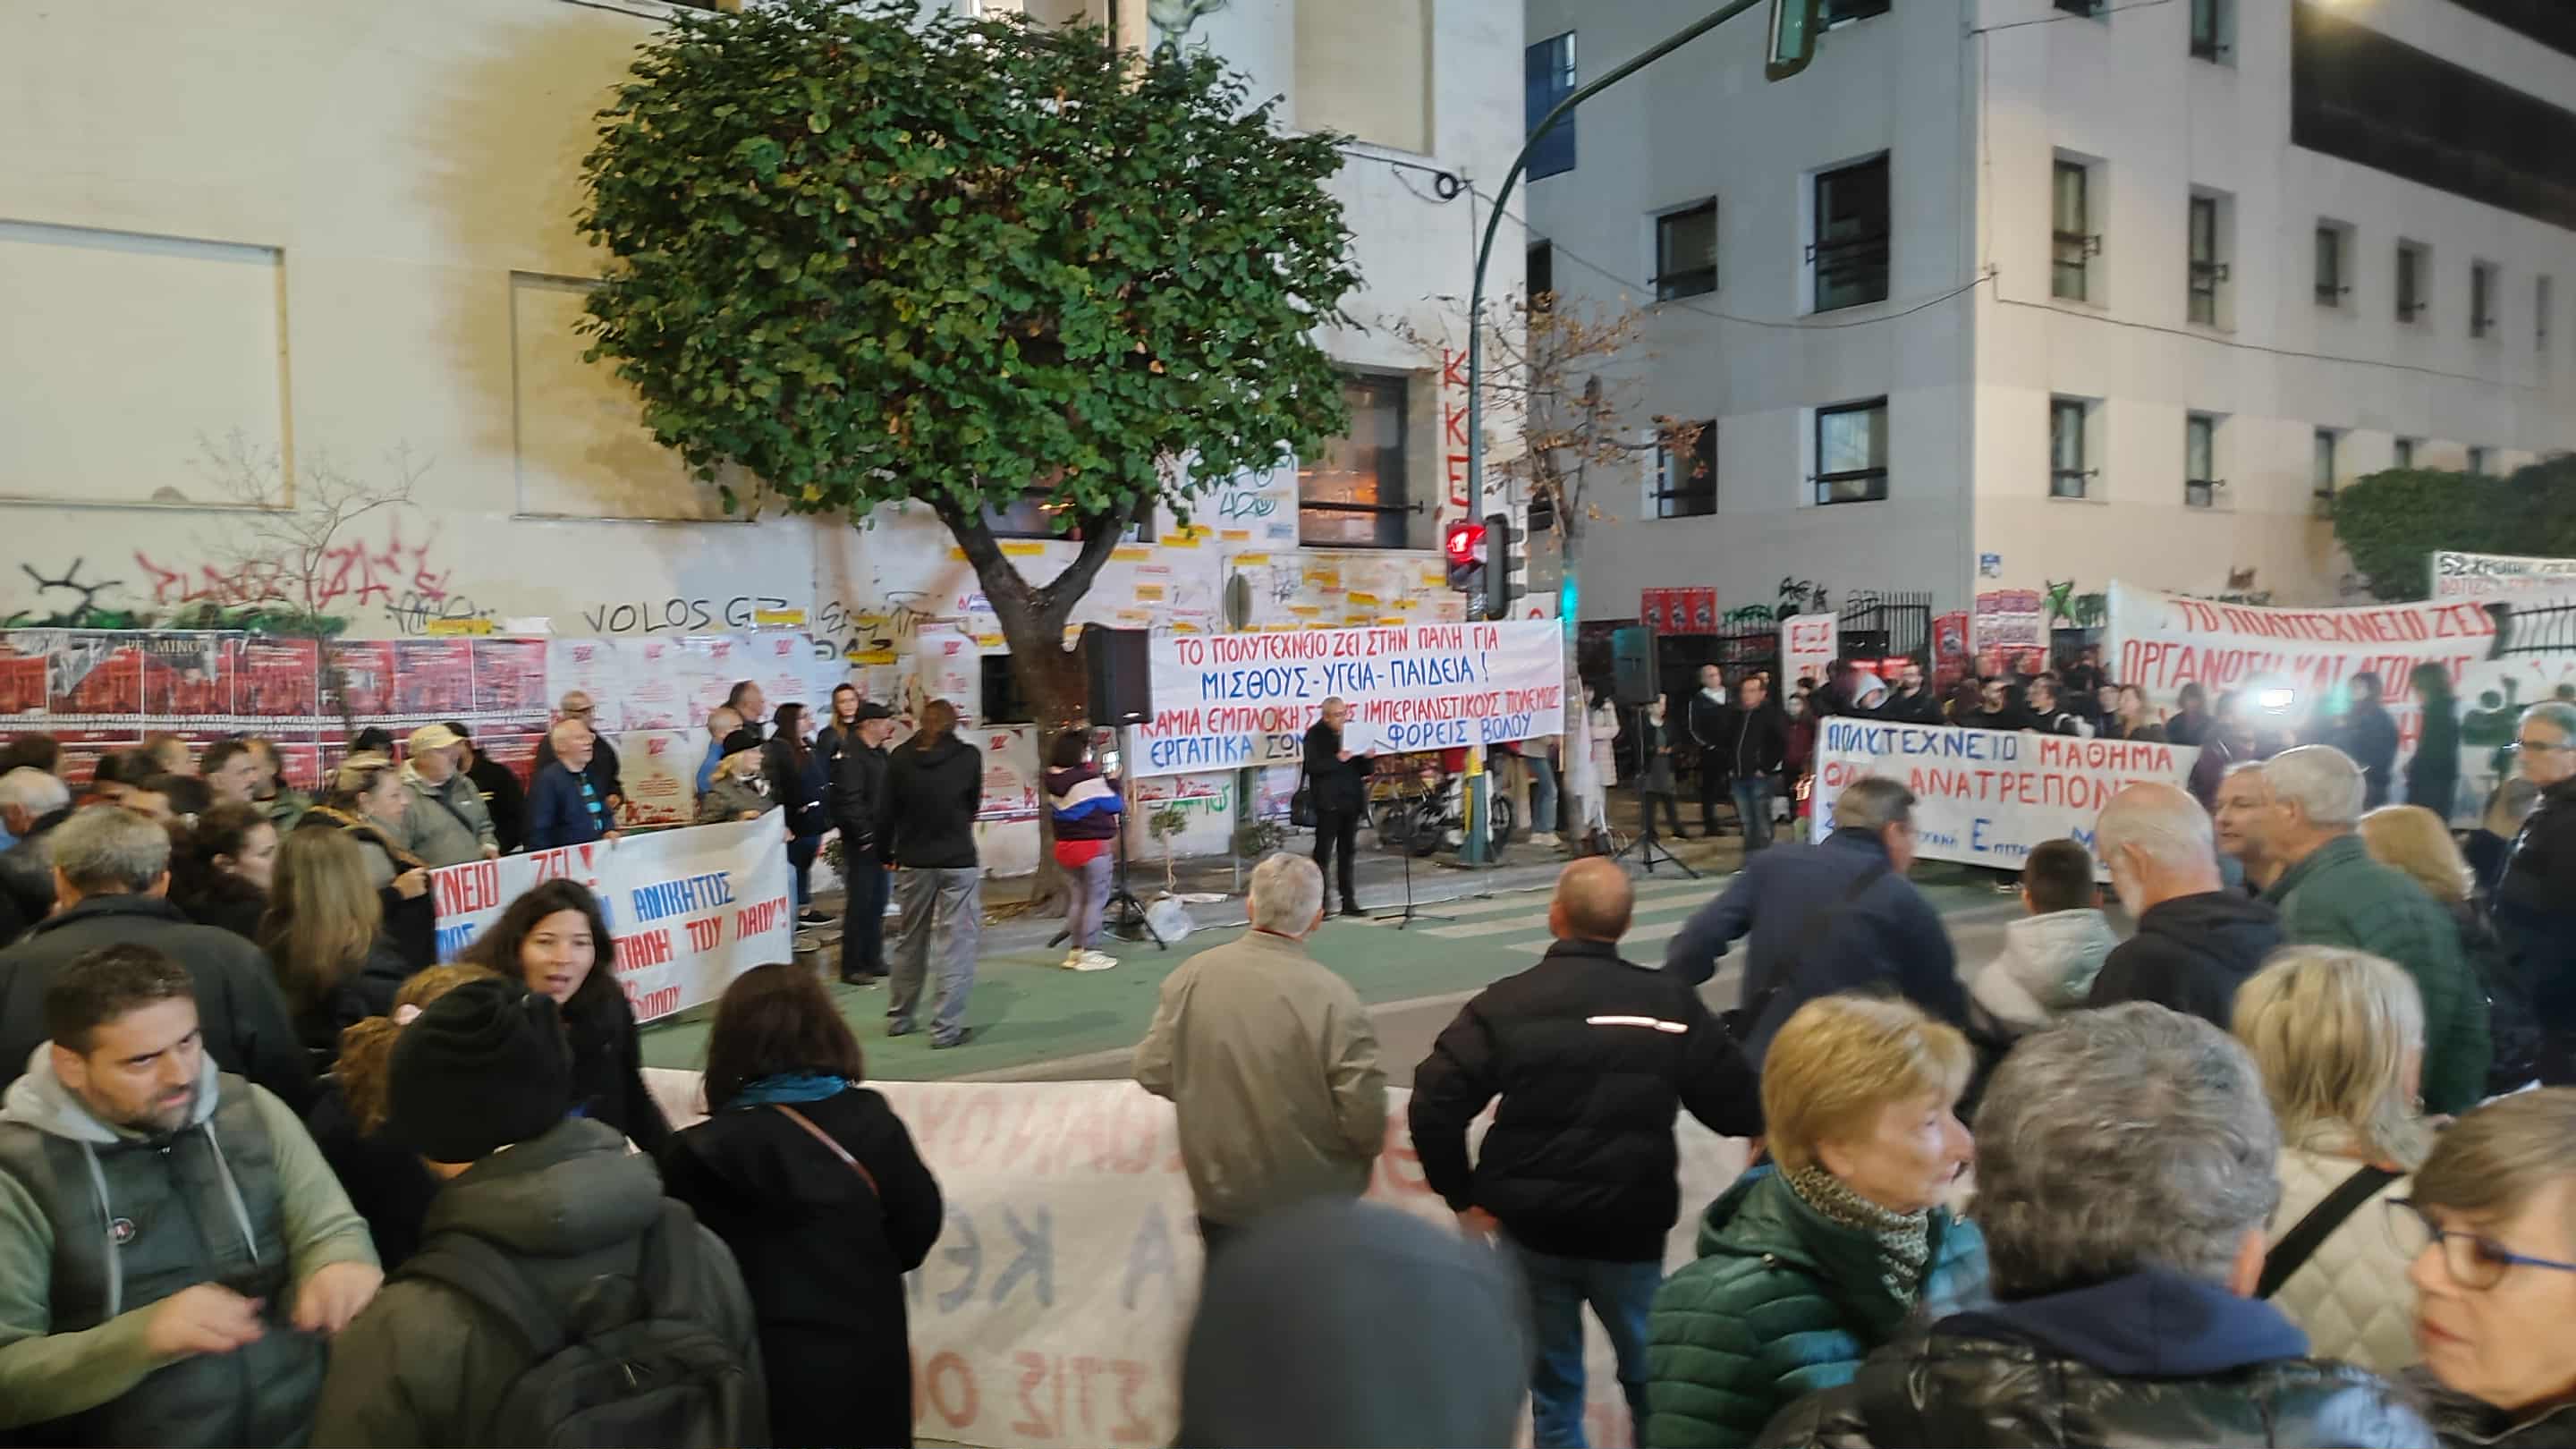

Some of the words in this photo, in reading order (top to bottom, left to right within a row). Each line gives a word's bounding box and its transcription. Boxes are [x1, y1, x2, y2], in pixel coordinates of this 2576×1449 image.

[584, 598, 711, 633] VOLOS
[2175, 600, 2219, 631] ΤΟ
[2221, 607, 2429, 643] ΠΟΛΥΤΕΧΝΕΙΟ
[2429, 601, 2498, 639] ΖΕΙ
[1174, 639, 1204, 665] ΤΟ
[1210, 631, 1327, 665] ΠΟΛΥΤΕΧΝΕΙΟ
[1333, 632, 1360, 657] ΖΕΙ
[1366, 628, 1409, 657] ΣΤΗΝ
[1418, 626, 1462, 651] ΠΑΛΗ
[1473, 625, 1499, 651] ΓΙΑ
[1140, 706, 1201, 739] ΚΑΜΙΑ
[1207, 704, 1300, 733] ΕΜΠΛΟΚΗ
[1364, 691, 1501, 724] ΙΜΠΕΡΙΑΛΙΣΤΙΚΟΥΣ
[1150, 734, 1255, 767] ΕΡΓΑΤΙΚΑ
[1387, 719, 1468, 750] ΦΟΡΕΙΣ
[1481, 712, 1532, 744] ΒΟΛΟΥ
[1827, 723, 2018, 761] ΠΟΛΥΤΕΧΝΕΙΟ
[2039, 737, 2174, 772] ΜΑΘΗΜΑ
[631, 871, 736, 923] ΑΝΙΚΗΤΟΣ
[685, 915, 723, 953] ΤΟΥ
